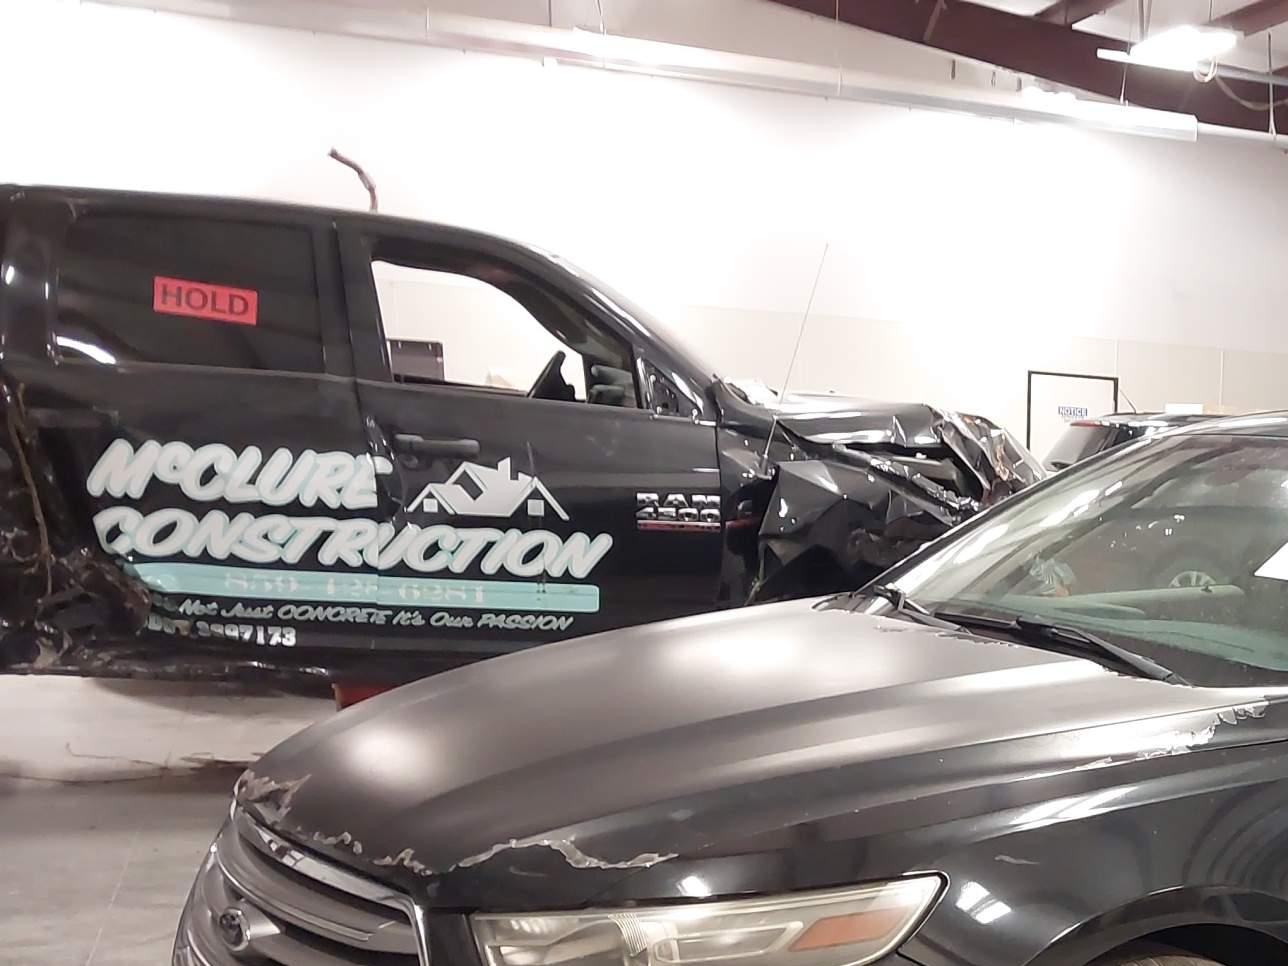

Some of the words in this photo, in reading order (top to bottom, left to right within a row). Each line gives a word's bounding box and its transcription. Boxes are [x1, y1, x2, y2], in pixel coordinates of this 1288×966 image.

[160, 283, 250, 316] HOLD
[1058, 405, 1088, 417] NOTICE
[636, 492, 721, 508] RAM
[92, 505, 614, 580] CONSTRUCTION
[179, 598, 219, 616] Not
[220, 602, 274, 619] Just
[277, 604, 393, 625] CONCRETE
[392, 611, 425, 626] It's
[429, 611, 474, 628] Our
[477, 613, 574, 631] PASSION
